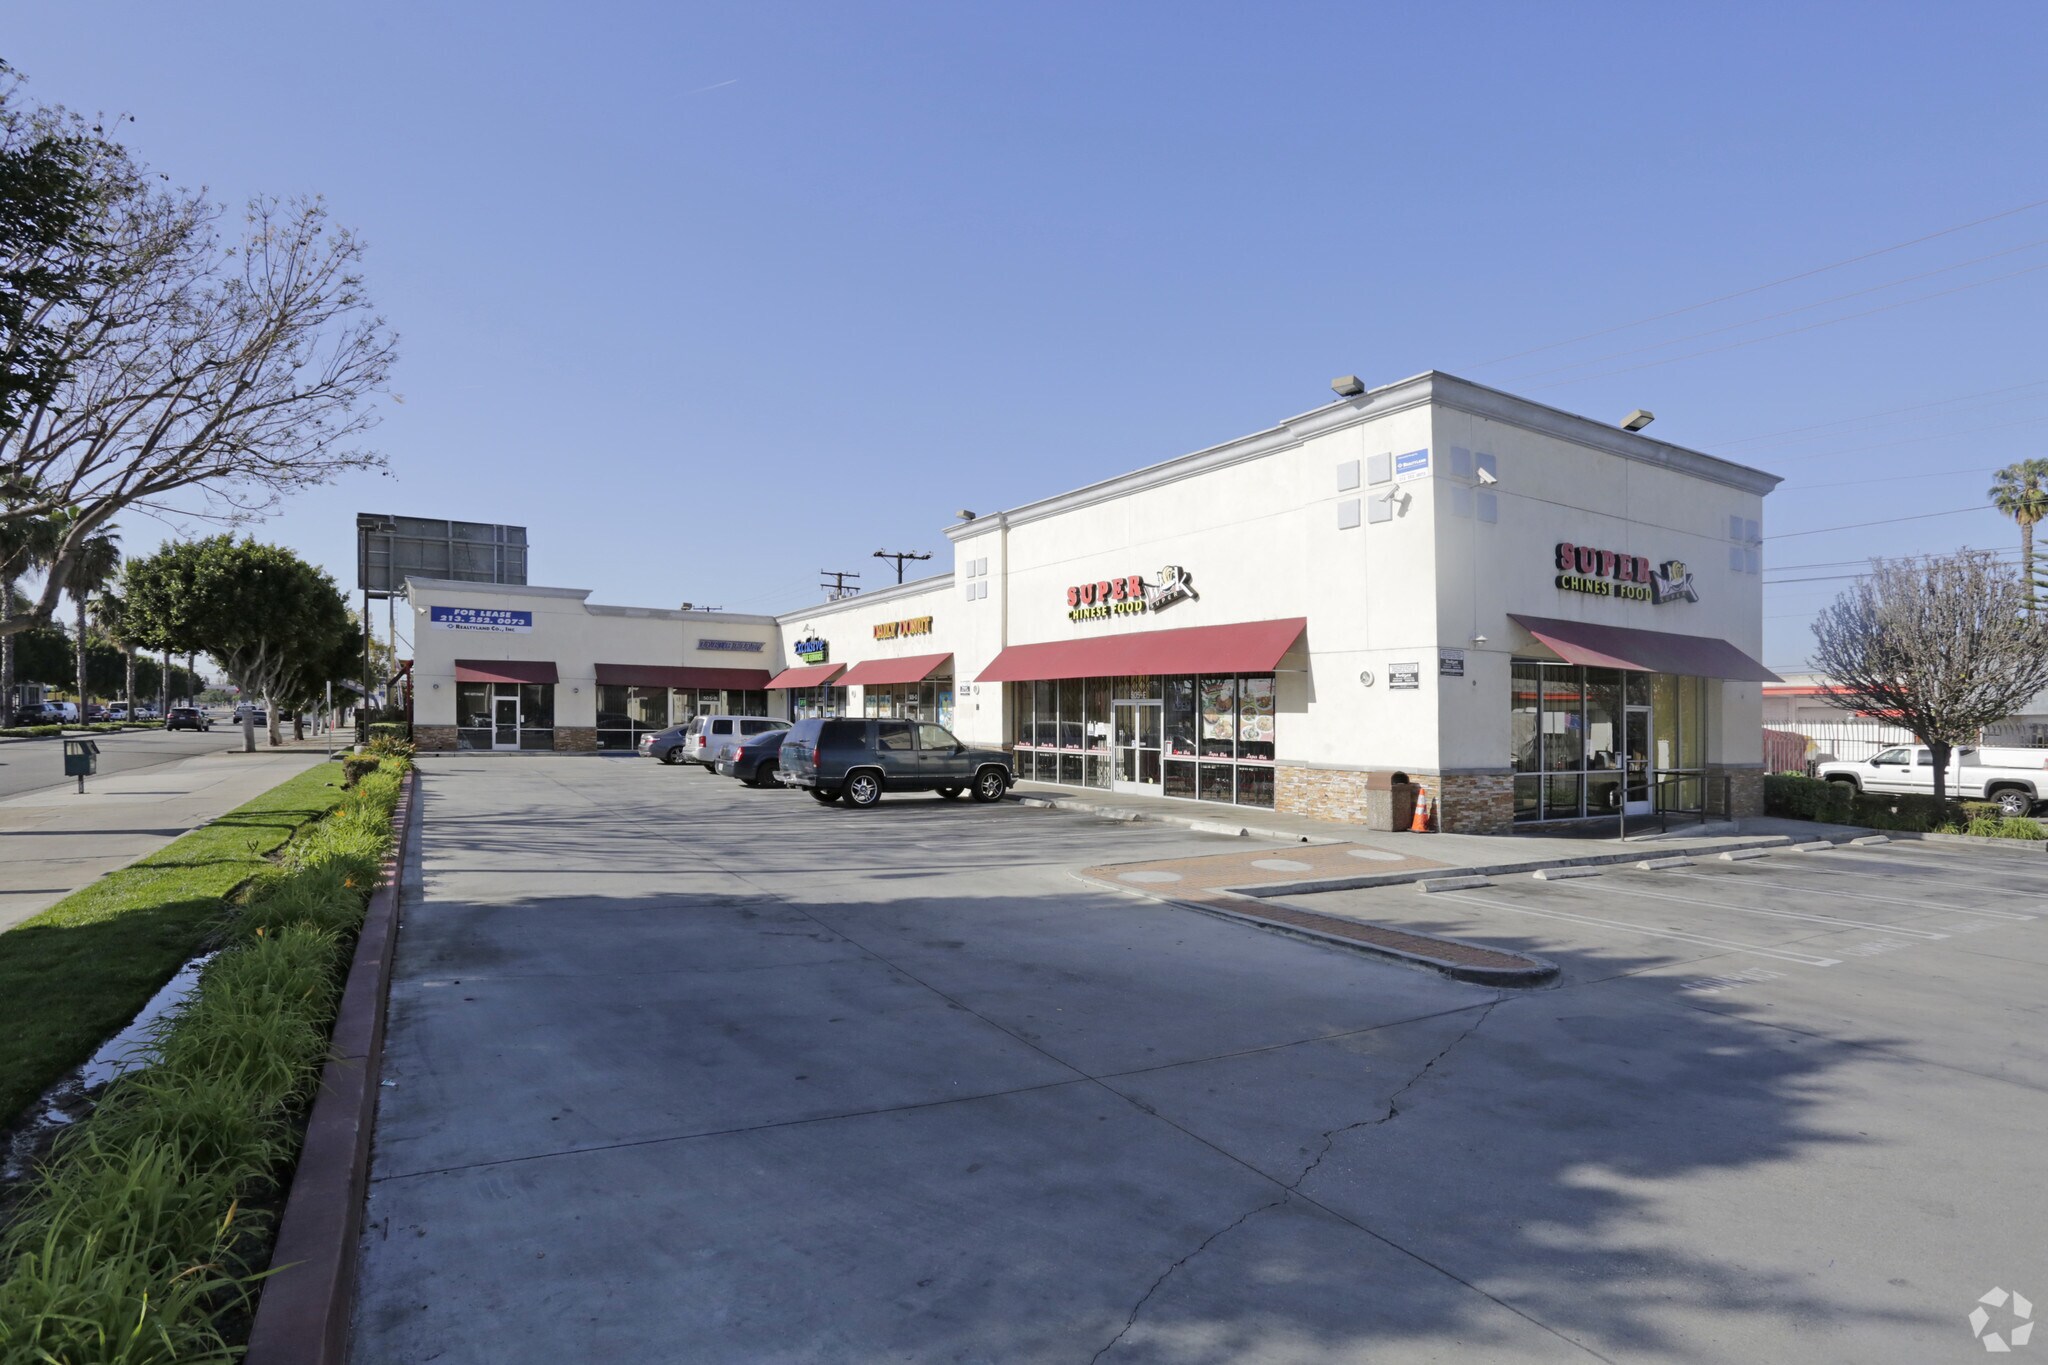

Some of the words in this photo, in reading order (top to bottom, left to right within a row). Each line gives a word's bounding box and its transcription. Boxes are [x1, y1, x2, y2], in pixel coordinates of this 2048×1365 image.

[1559, 542, 1652, 584] SUPER
[1067, 575, 1143, 607] SUPER
[1561, 575, 1614, 595] CHINESE
[1620, 585, 1652, 600] FOOD
[1111, 601, 1143, 614] FOOD
[1150, 591, 1179, 608] SUPER
[468, 616, 494, 624] 252.
[480, 610, 512, 618] LEASE
[873, 622, 897, 639] DAILY
[900, 616, 931, 636] DONUT
